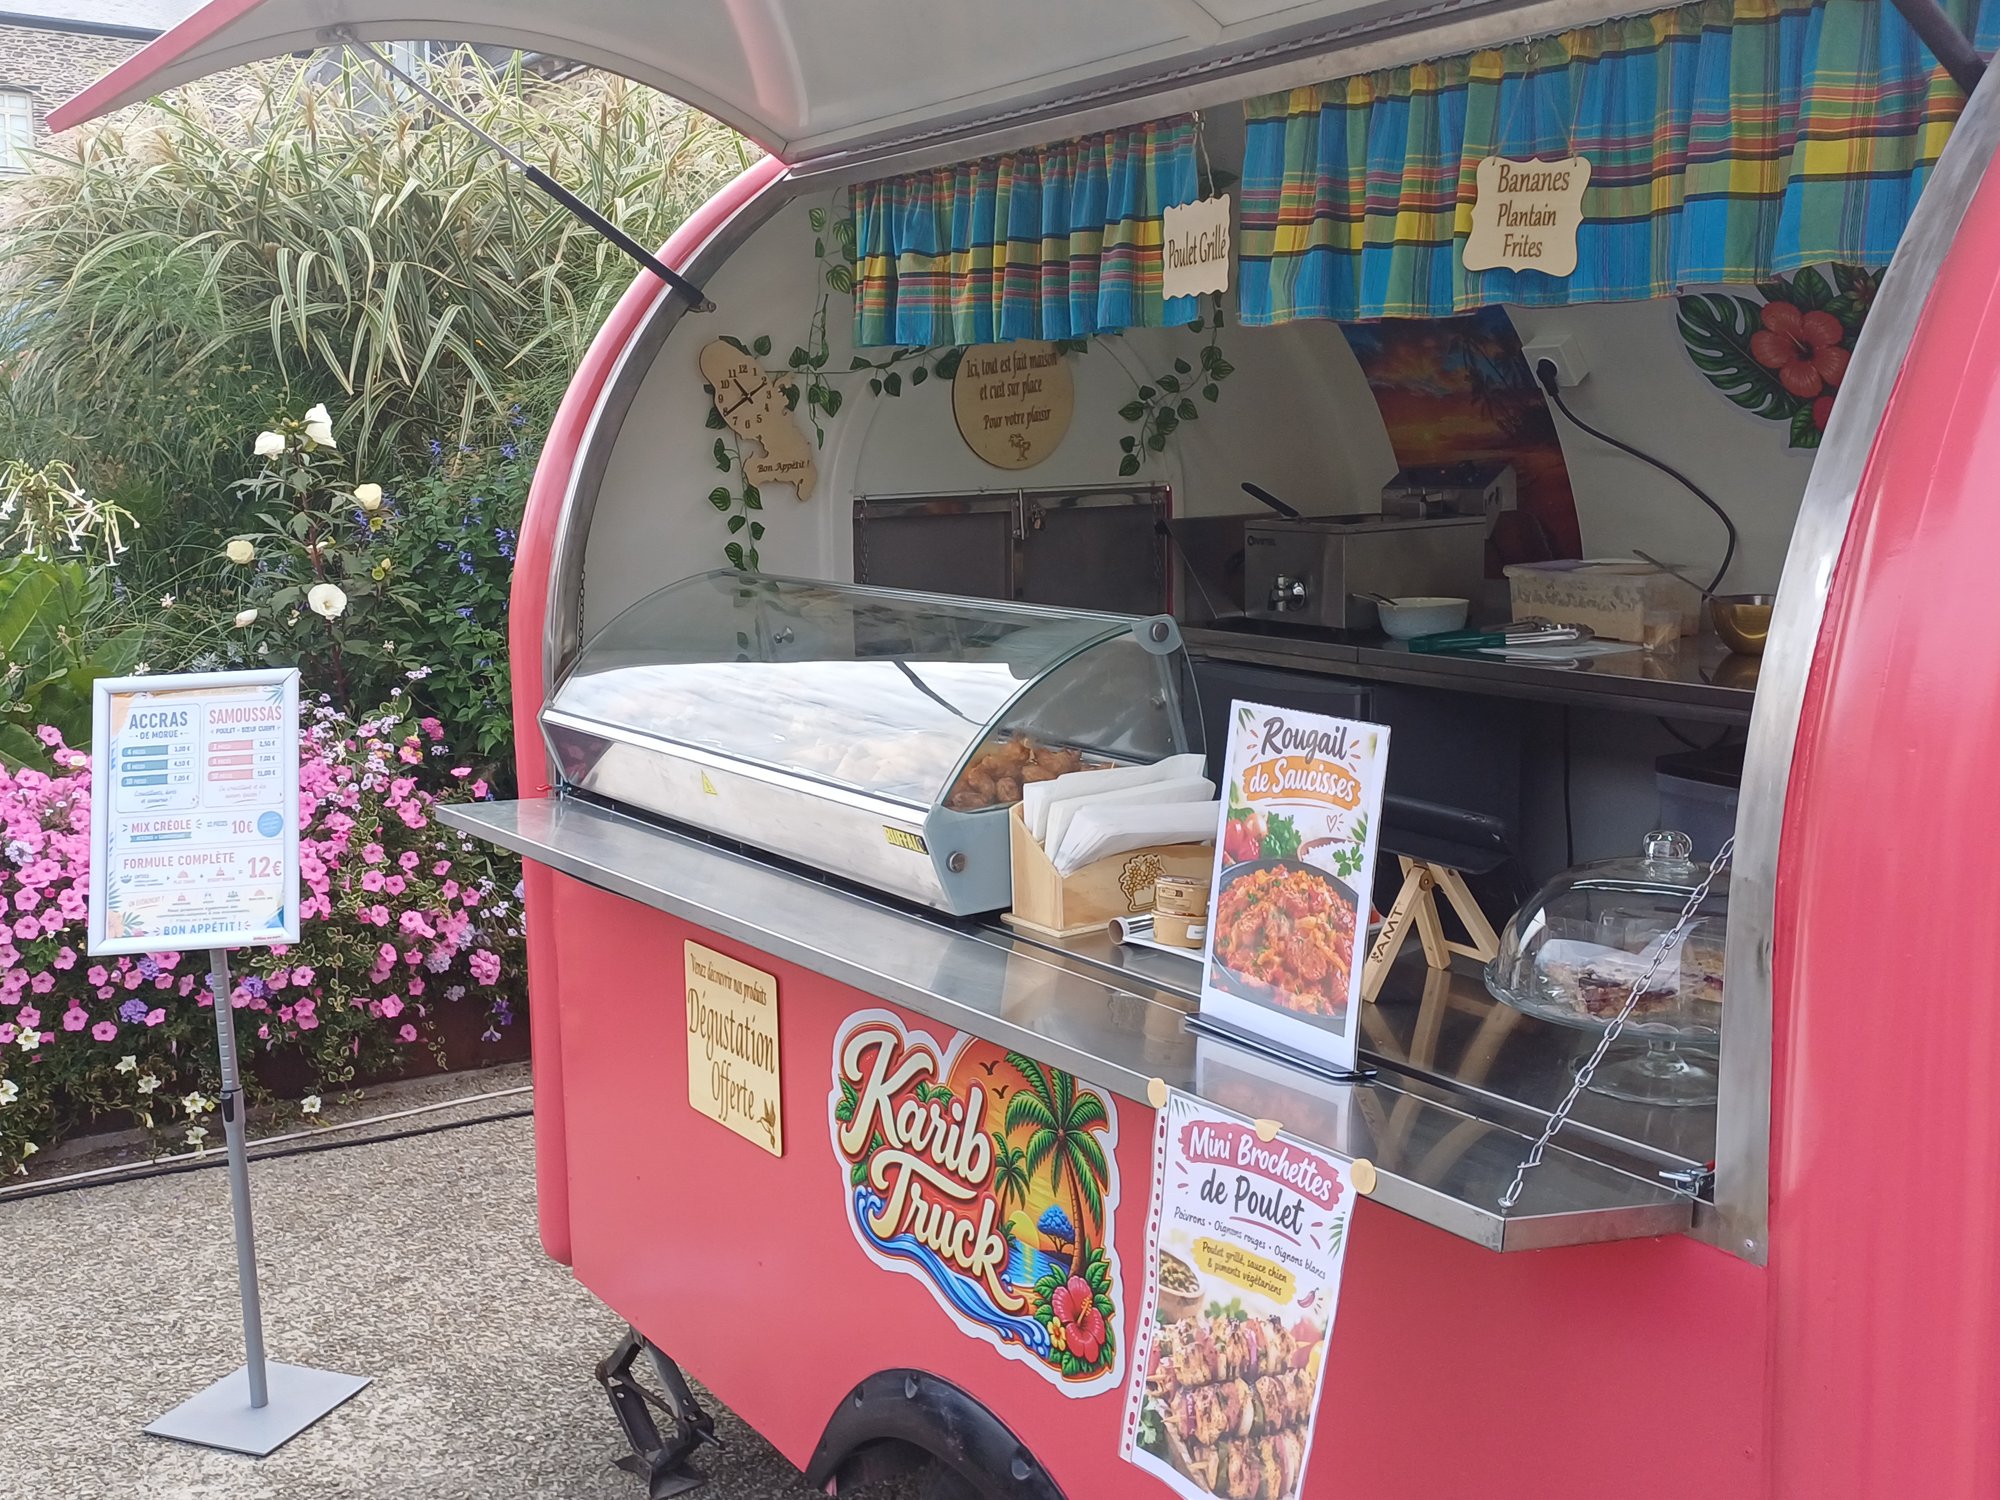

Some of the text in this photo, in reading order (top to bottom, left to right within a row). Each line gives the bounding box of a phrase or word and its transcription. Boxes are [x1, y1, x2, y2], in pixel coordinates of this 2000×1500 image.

[1497, 164, 1570, 193] Bananes
[1497, 200, 1557, 227] Plantain
[1168, 224, 1226, 269] Poulet Grillé
[1502, 233, 1543, 258] Frites
[728, 369, 737, 378] 11
[739, 364, 748, 374] 12
[753, 368, 757, 376] 1
[967, 349, 1057, 379] Ici, tout est fait maison
[720, 379, 730, 389] 10
[766, 390, 772, 399] 3
[980, 373, 1042, 402] et cuit sur place
[718, 394, 724, 403] 9
[733, 416, 738, 425] 7
[745, 420, 750, 429] 6
[756, 414, 762, 423] 5
[983, 404, 1051, 430] Pour votre plaisir
[757, 464, 773, 472] Bon
[128, 711, 188, 730] ACCRAS
[209, 705, 282, 725] SAMOUSSAS
[140, 730, 179, 740] DE MORUE
[1261, 717, 1348, 764] Rougail
[1250, 758, 1356, 802] de Saucisses
[131, 819, 192, 833] MIX CRÉOLE
[123, 851, 235, 870] FORMULE COMPLÈTE
[163, 925, 186, 936] BON
[189, 921, 236, 934] APPÉTIT
[690, 952, 706, 978] Venez
[688, 988, 776, 1074] Dégustation
[711, 1059, 755, 1121] Offerte
[841, 1030, 991, 1184] Karib
[1189, 1126, 1332, 1201] Mini Brochettes
[1200, 1168, 1305, 1235] de Poulet
[869, 1149, 1025, 1310] Truck
[1173, 1206, 1326, 1280] Poivrons Oignons rouges Oignons blancs
[1202, 1241, 1224, 1257] Poulet
[1247, 1259, 1266, 1274] sauce
[1268, 1265, 1287, 1283] chien
[1242, 1270, 1283, 1296] végétariens
